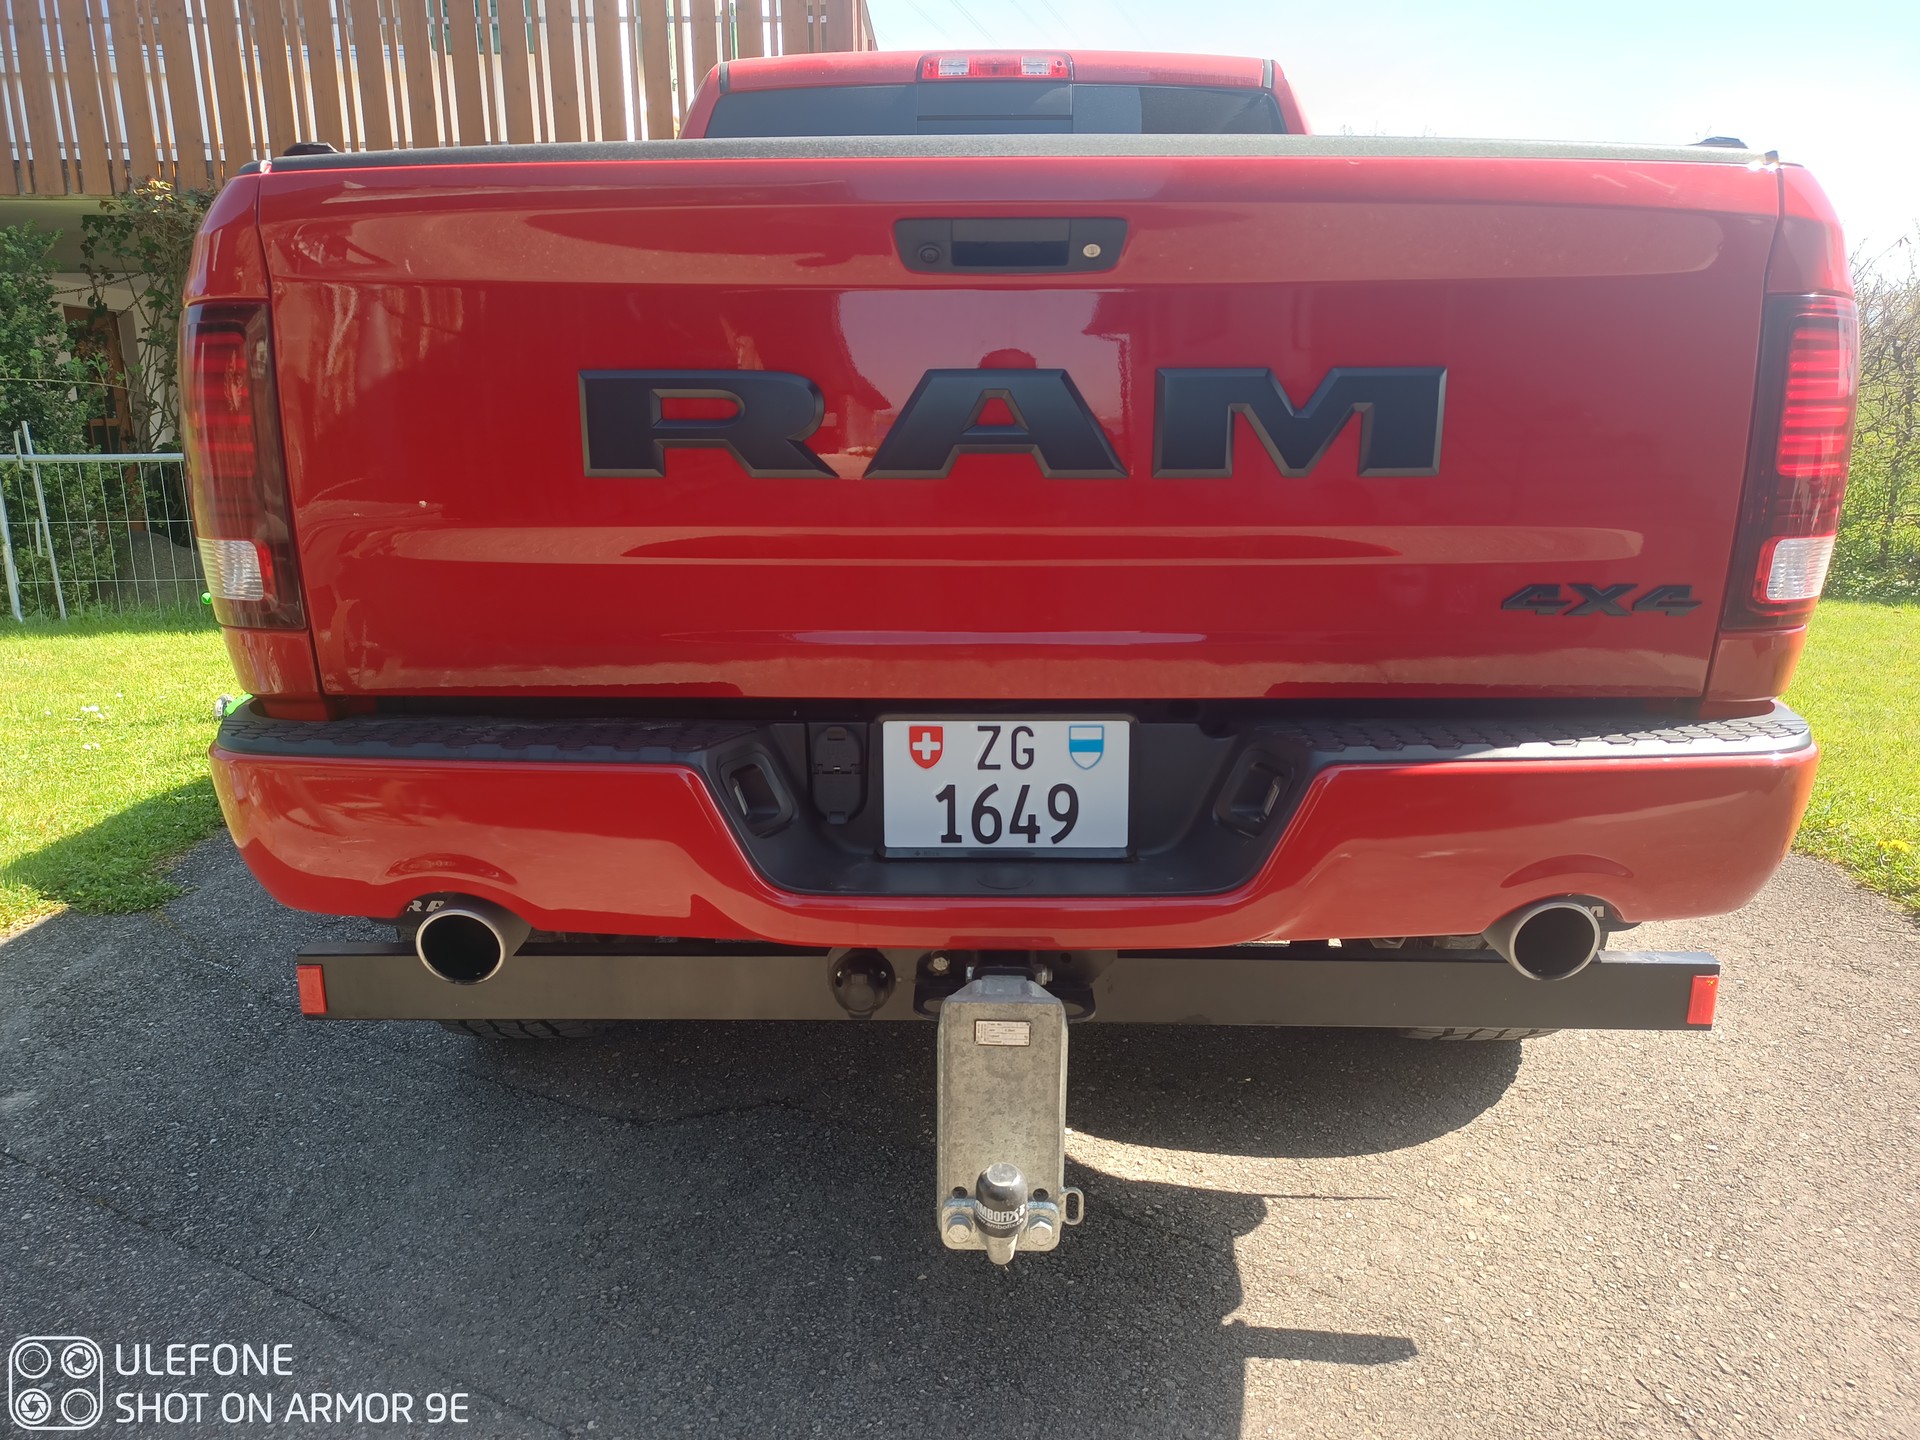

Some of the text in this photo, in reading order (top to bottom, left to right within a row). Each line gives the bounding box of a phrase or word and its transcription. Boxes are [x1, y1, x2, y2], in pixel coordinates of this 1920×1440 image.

[578, 367, 1447, 478] RAM
[1501, 583, 1703, 616] 4X4
[977, 725, 1035, 770] ZG
[935, 783, 1079, 845] 1649
